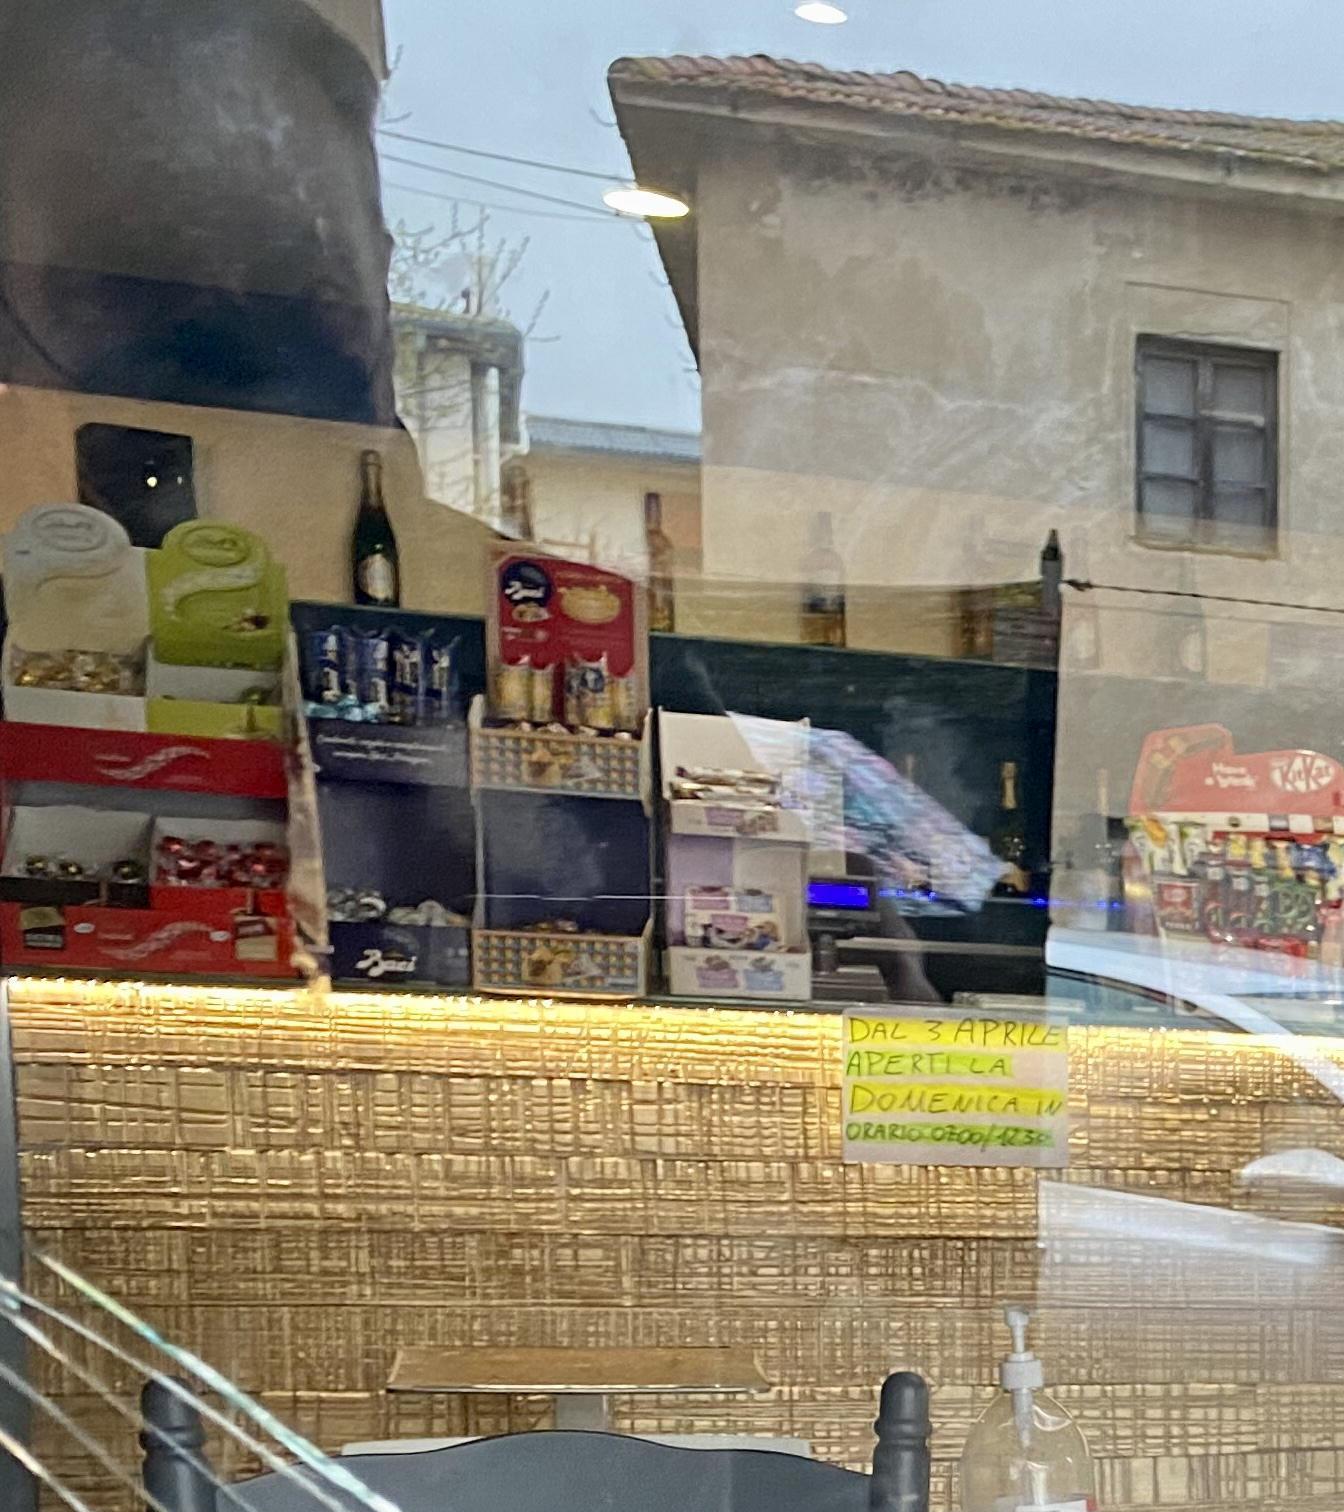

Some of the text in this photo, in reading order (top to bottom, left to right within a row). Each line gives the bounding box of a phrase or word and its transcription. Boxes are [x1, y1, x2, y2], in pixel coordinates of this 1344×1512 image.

[849, 1017, 1061, 1047] DAL 3 APRILE
[846, 1051, 1008, 1077] APERTI LA
[850, 1084, 1063, 1117] DOMENICA IN
[845, 1122, 923, 1142] ORARIO
